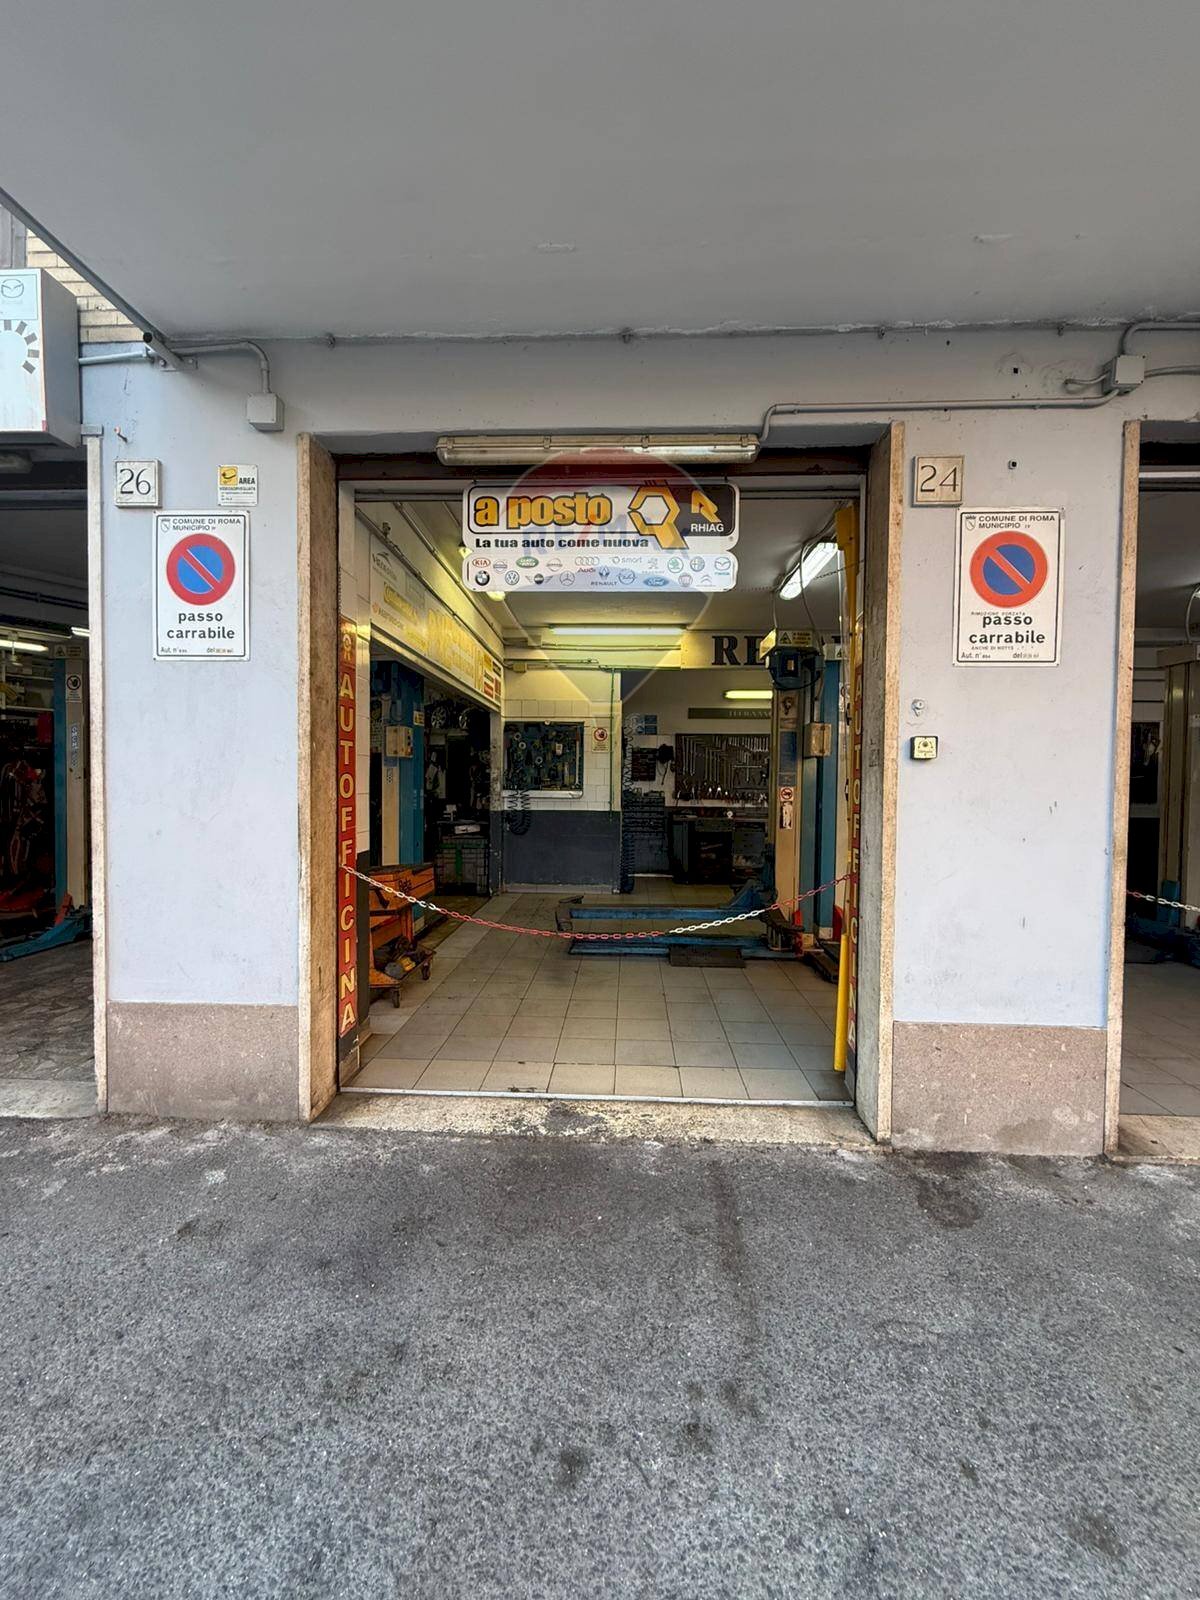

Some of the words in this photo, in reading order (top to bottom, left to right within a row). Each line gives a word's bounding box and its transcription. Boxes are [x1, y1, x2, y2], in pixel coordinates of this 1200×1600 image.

[120, 468, 151, 495] 26
[239, 477, 255, 485] AREA
[920, 464, 959, 492] 24
[473, 495, 499, 526] a
[506, 491, 613, 530] posto
[690, 523, 725, 533] RHIAG
[475, 538, 491, 548] La
[494, 538, 518, 548] tua
[522, 538, 555, 548] auto
[559, 538, 598, 548] come
[602, 538, 649, 548] nuova
[178, 612, 223, 624] passo
[982, 615, 1033, 629] passo
[166, 626, 235, 639] carrabile
[968, 630, 1046, 644] carrabile
[338, 673, 356, 1033] AUTOFFICINA
